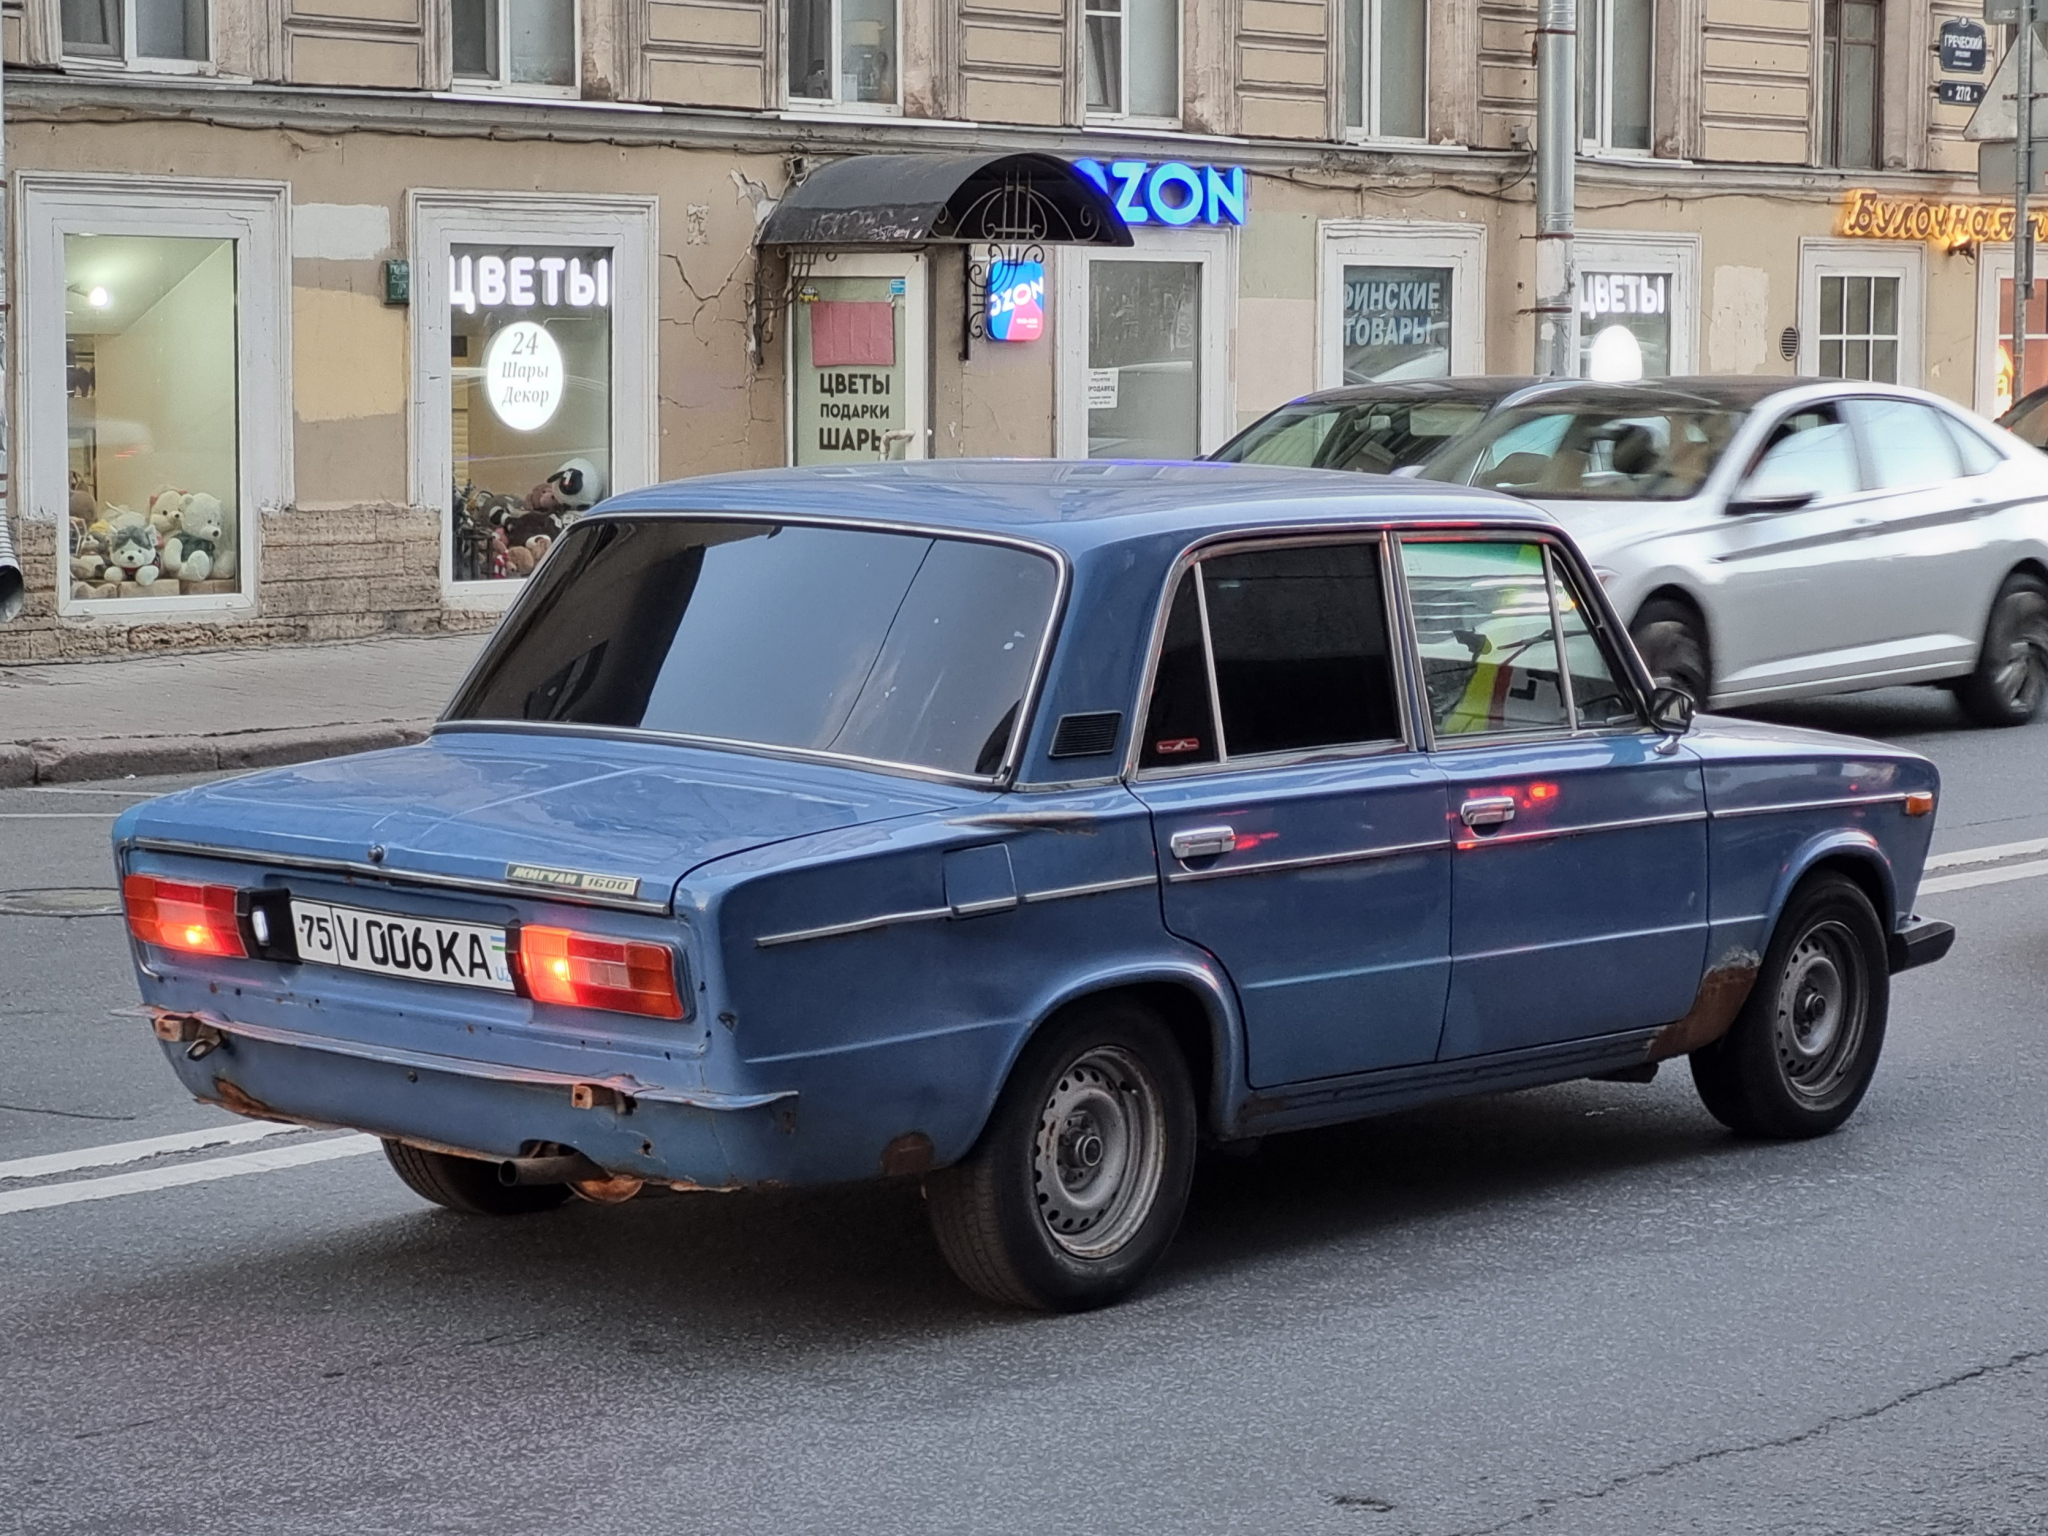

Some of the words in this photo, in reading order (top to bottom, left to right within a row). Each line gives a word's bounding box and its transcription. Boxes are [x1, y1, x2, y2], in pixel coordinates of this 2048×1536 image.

[1074, 158, 1244, 226] ZON
[449, 255, 608, 315] ЦВЕТЫ
[1580, 274, 1665, 320] ЦВЕТЫ
[511, 331, 539, 355] 24
[1344, 316, 1432, 346] ТОВАРЫ
[501, 361, 549, 383] Шары
[501, 386, 549, 407] Декор
[819, 372, 890, 397] ЦВЕТЫ
[820, 403, 890, 421] ПОДАРКИ
[588, 876, 629, 892] 1600
